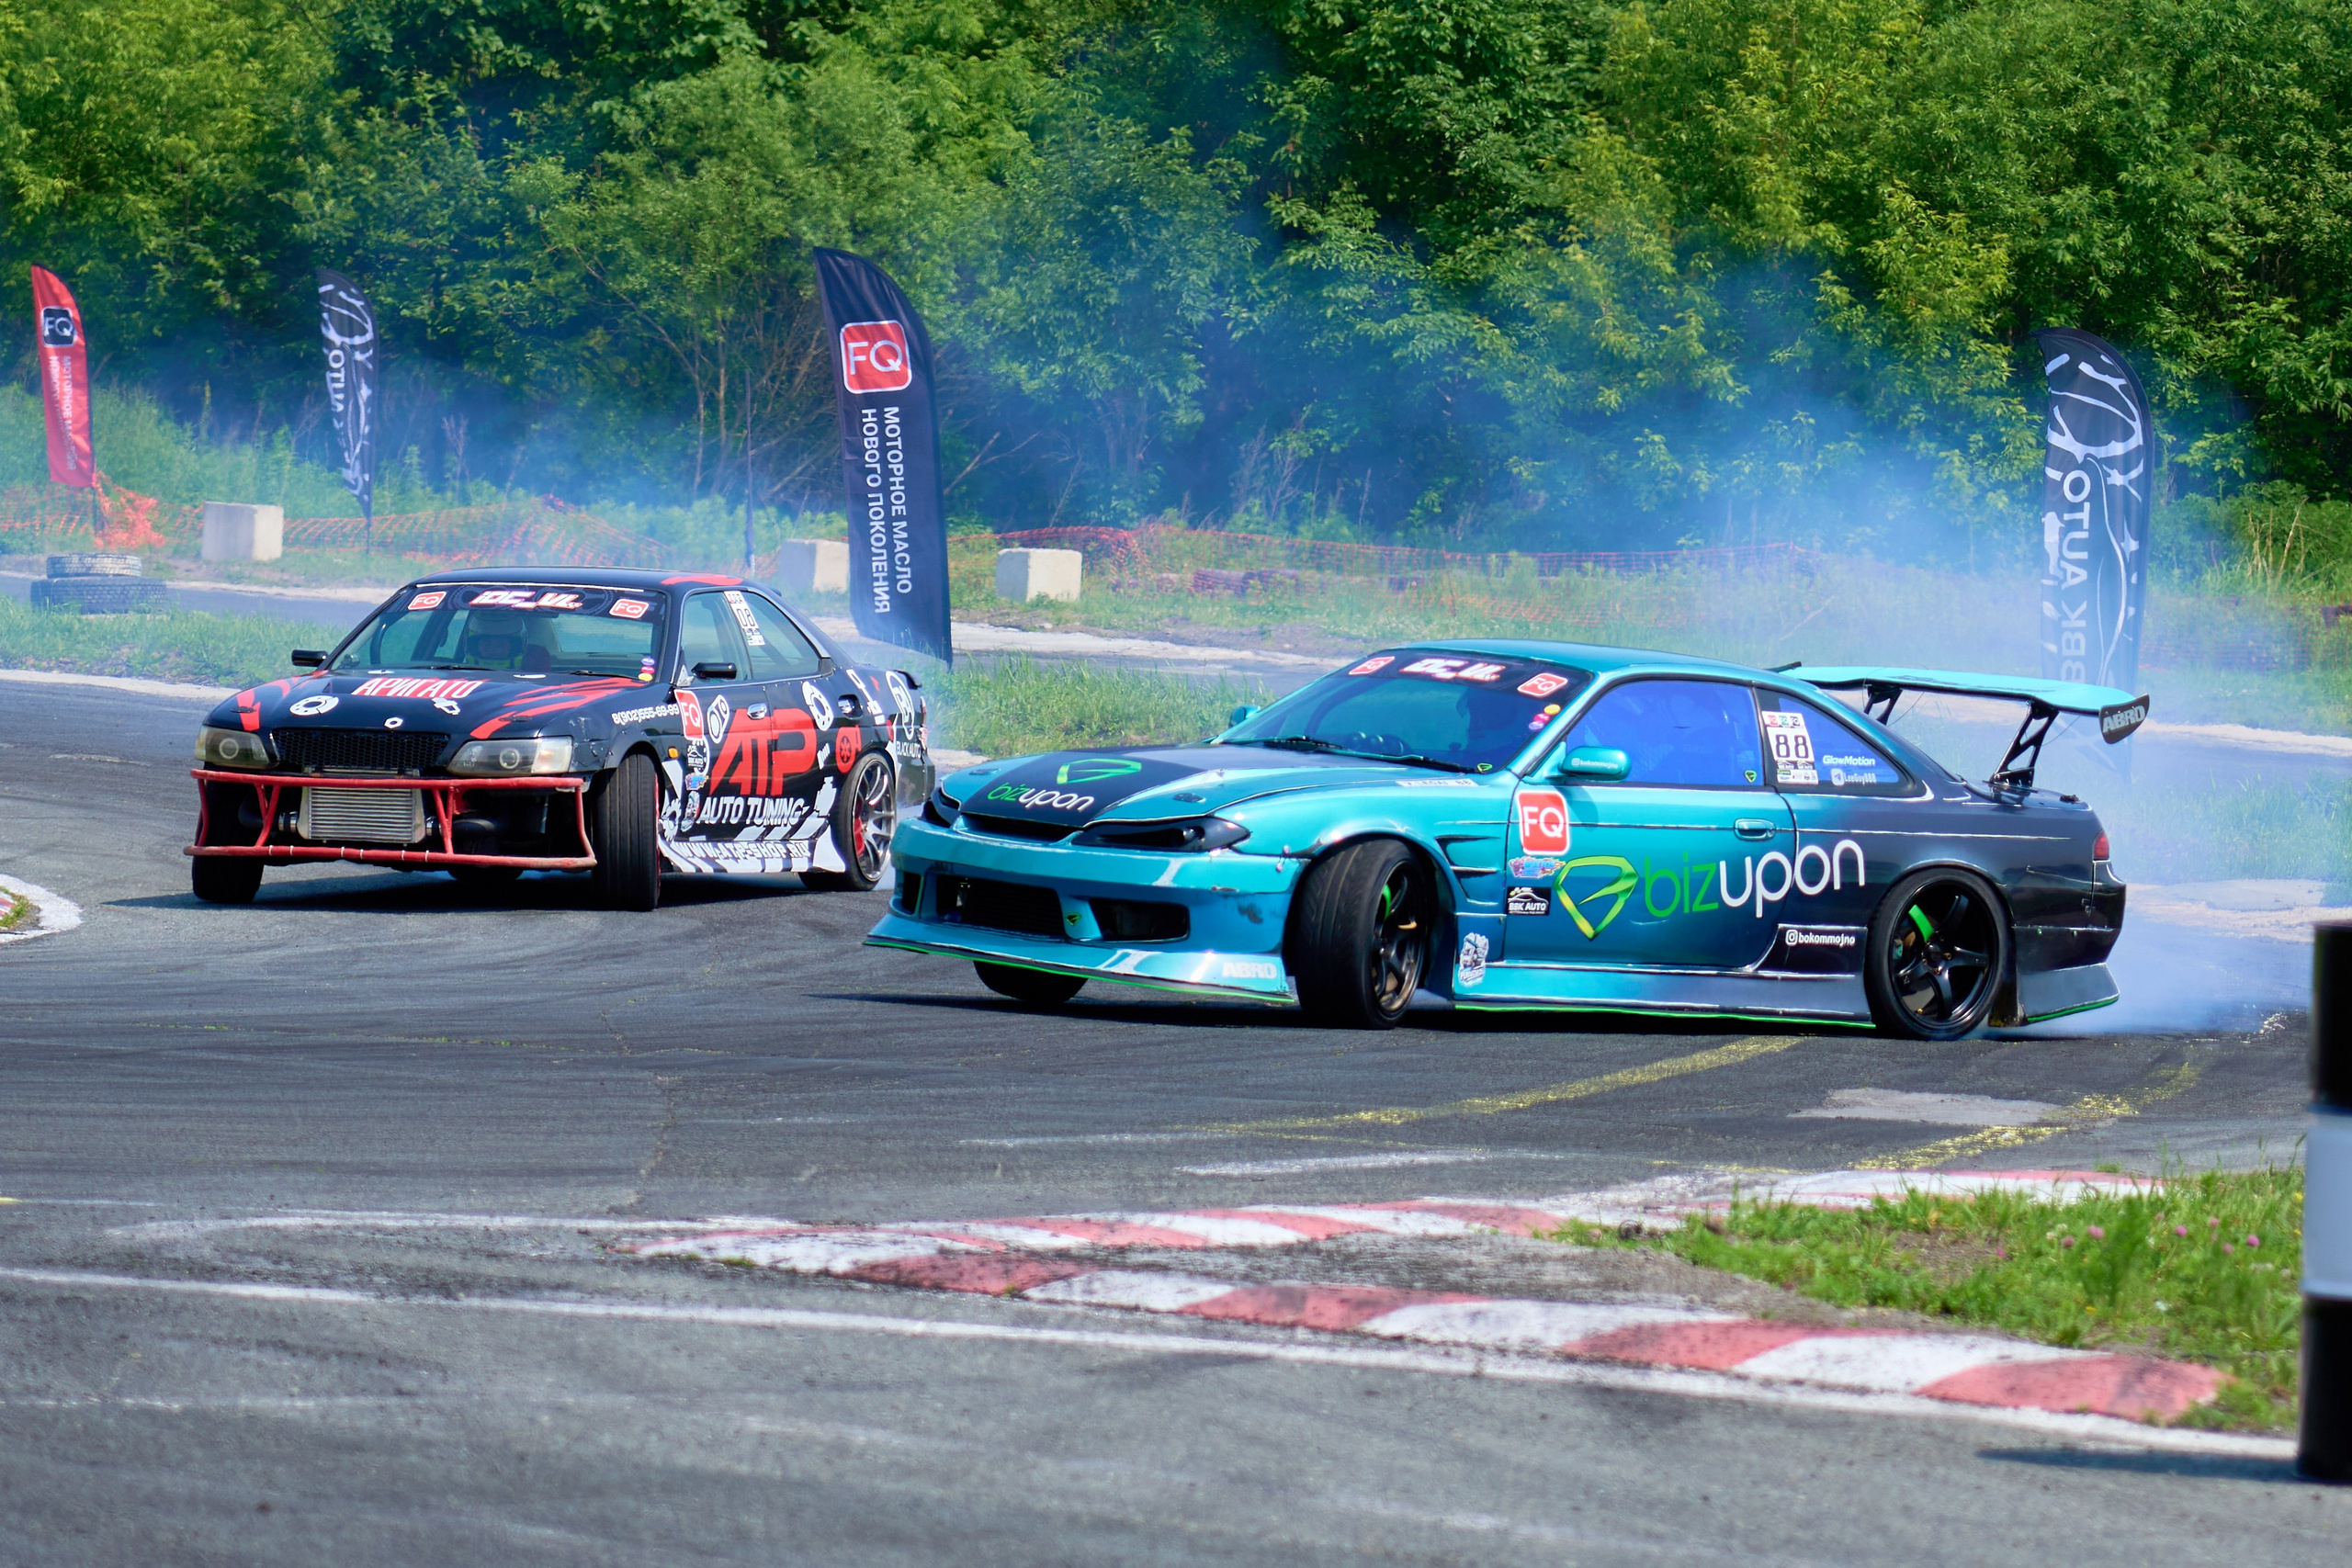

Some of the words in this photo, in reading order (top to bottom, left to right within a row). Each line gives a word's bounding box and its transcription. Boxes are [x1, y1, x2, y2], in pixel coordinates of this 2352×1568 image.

[43, 317, 74, 337] FQ
[847, 340, 903, 375] FQ
[862, 408, 881, 488] НОВОГО
[884, 406, 907, 515] МОТОРНОЕ
[868, 492, 890, 614] ПОКОЛЕНИЯ
[892, 520, 912, 593] МАСЛО
[413, 596, 439, 606] FQ
[615, 604, 643, 615] FQ
[351, 677, 484, 698] АРИГАТО
[1530, 676, 1557, 691] FQ
[680, 702, 701, 728] FQ
[2102, 705, 2146, 733] ABRO
[1775, 733, 1809, 759] 88
[1822, 754, 1876, 766] GlowMotion
[987, 782, 1095, 811] bizupon
[696, 795, 745, 824] AUTO
[745, 796, 806, 827] TUNING
[1522, 806, 1565, 838] FQ
[1644, 839, 1866, 919] bizupon
[1525, 902, 1547, 911] AUTO
[1798, 931, 1856, 947] bokommojno
[1222, 962, 1277, 979] ABRO
